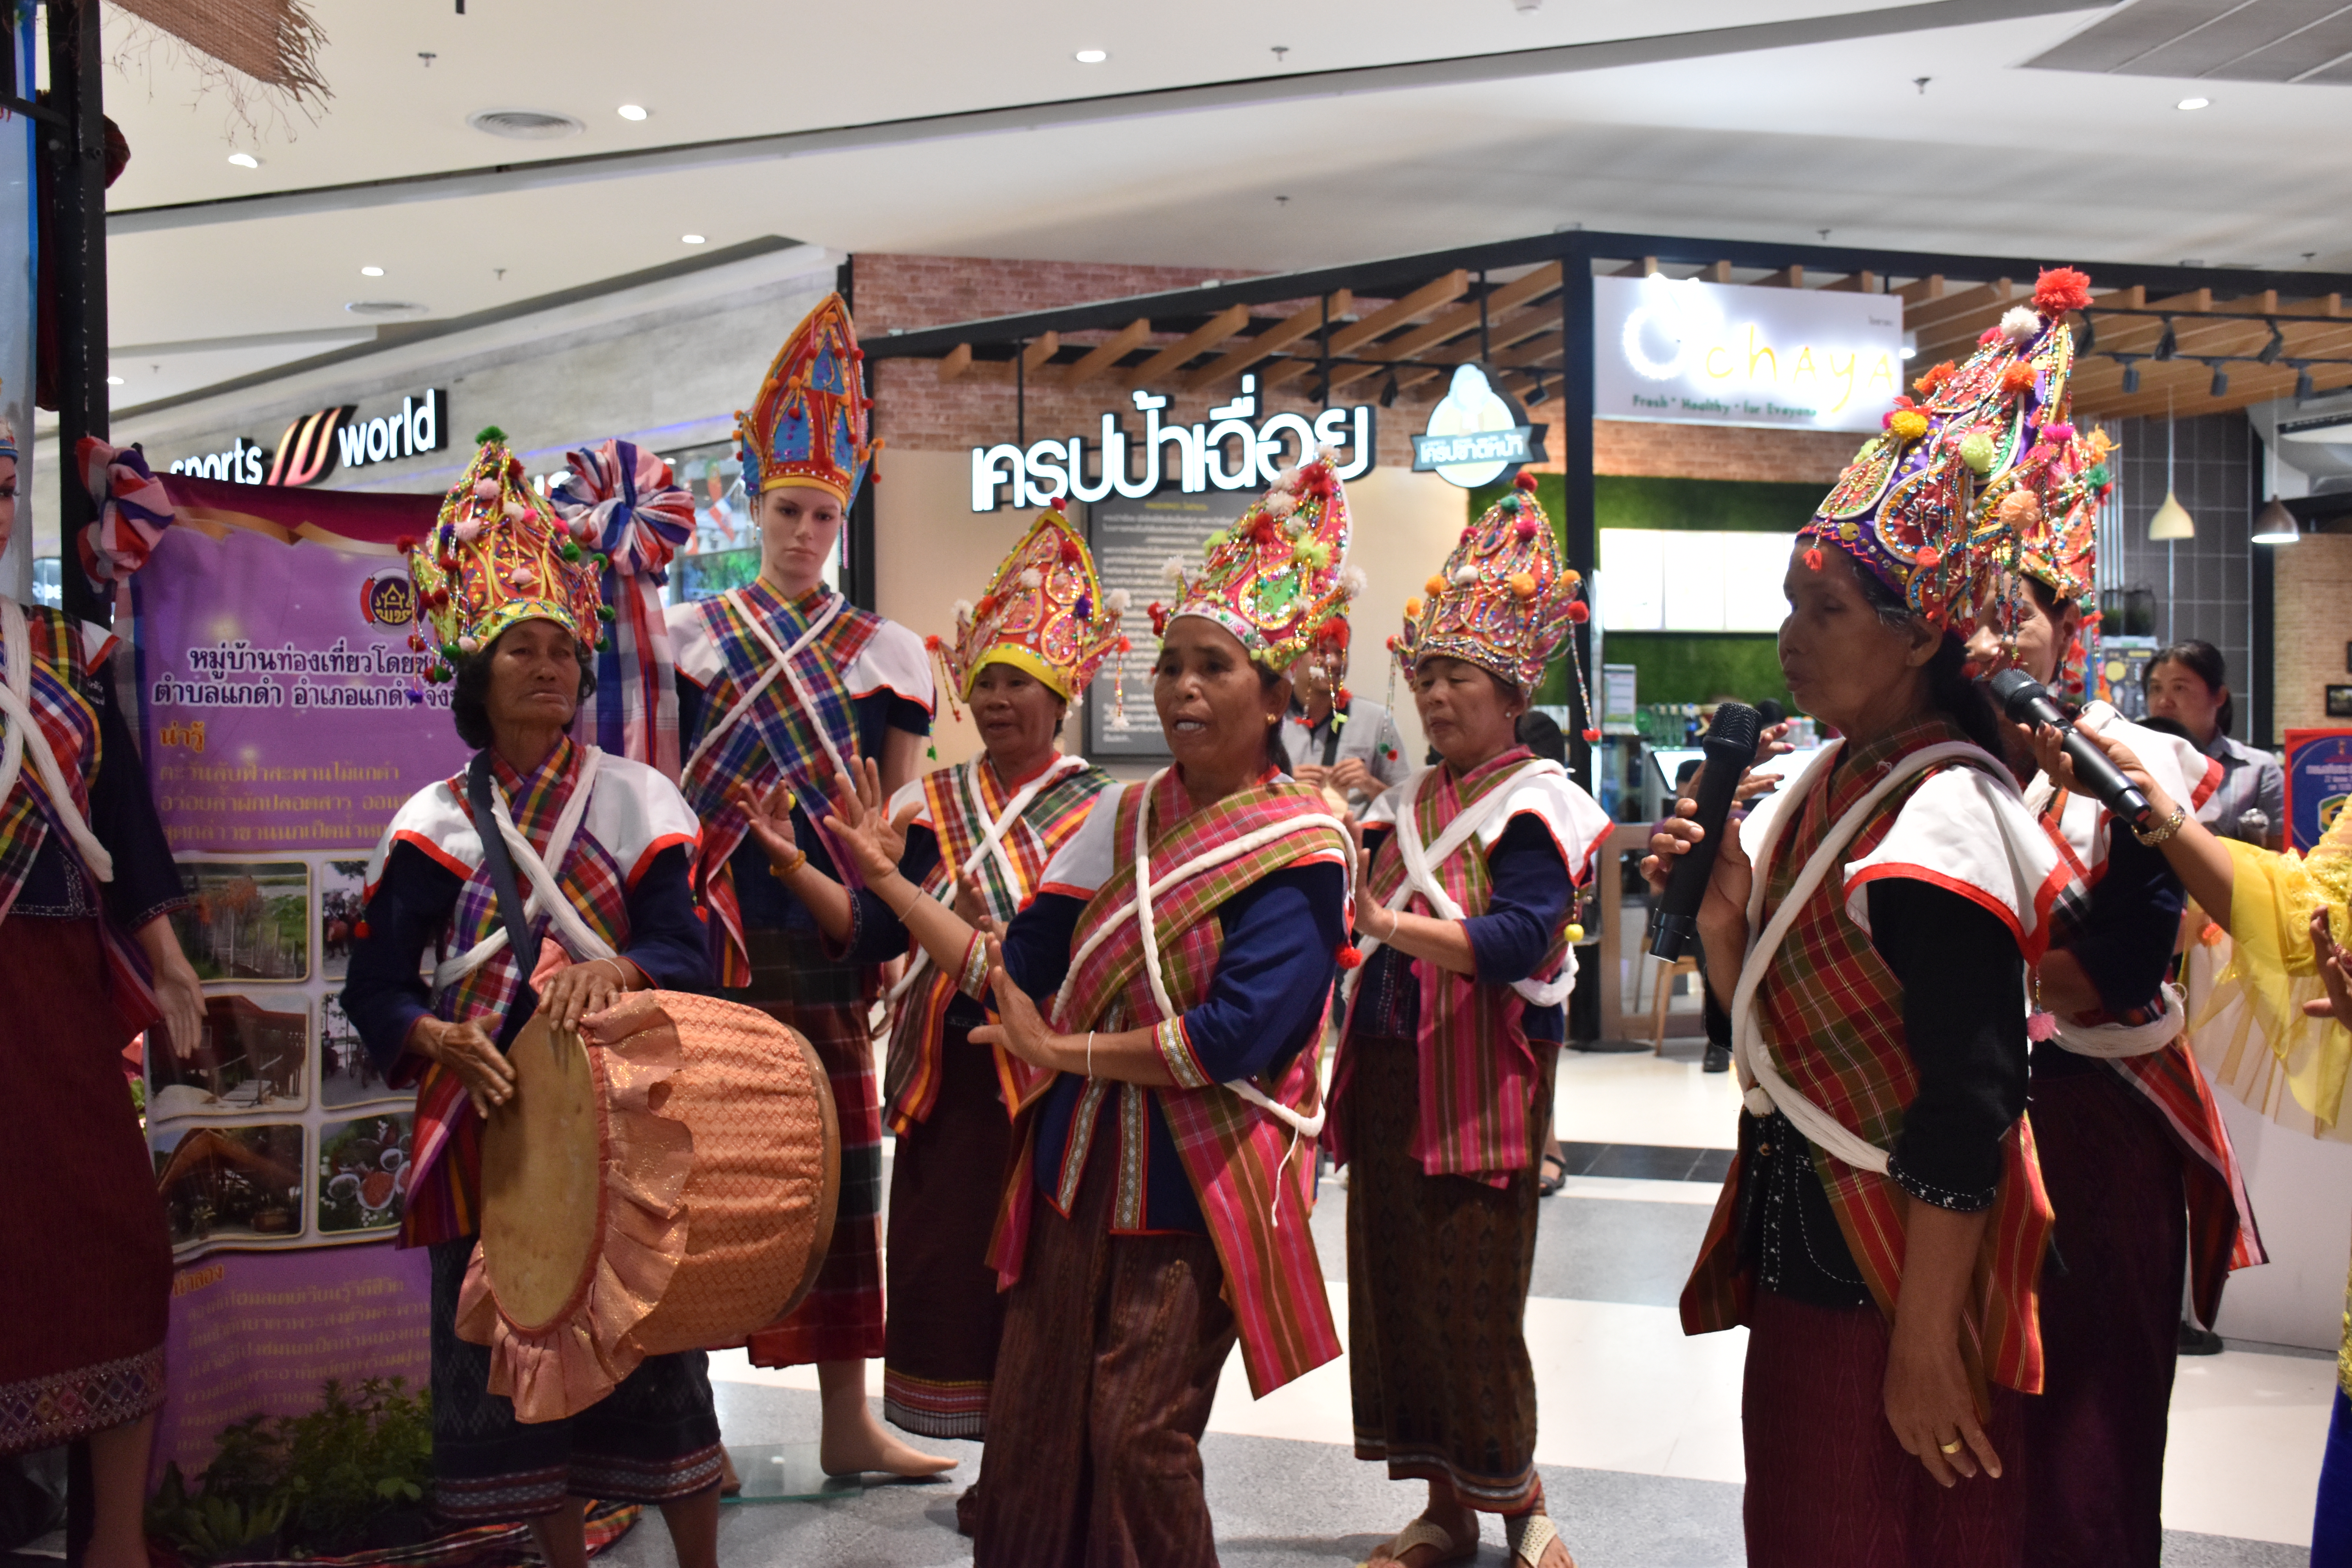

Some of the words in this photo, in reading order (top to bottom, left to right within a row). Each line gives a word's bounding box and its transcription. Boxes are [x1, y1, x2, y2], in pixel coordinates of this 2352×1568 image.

[338, 388, 436, 468] world
[972, 374, 1368, 512] เครปป้าเฉื่อย
[154, 676, 283, 706] ตำบลแกดำ
